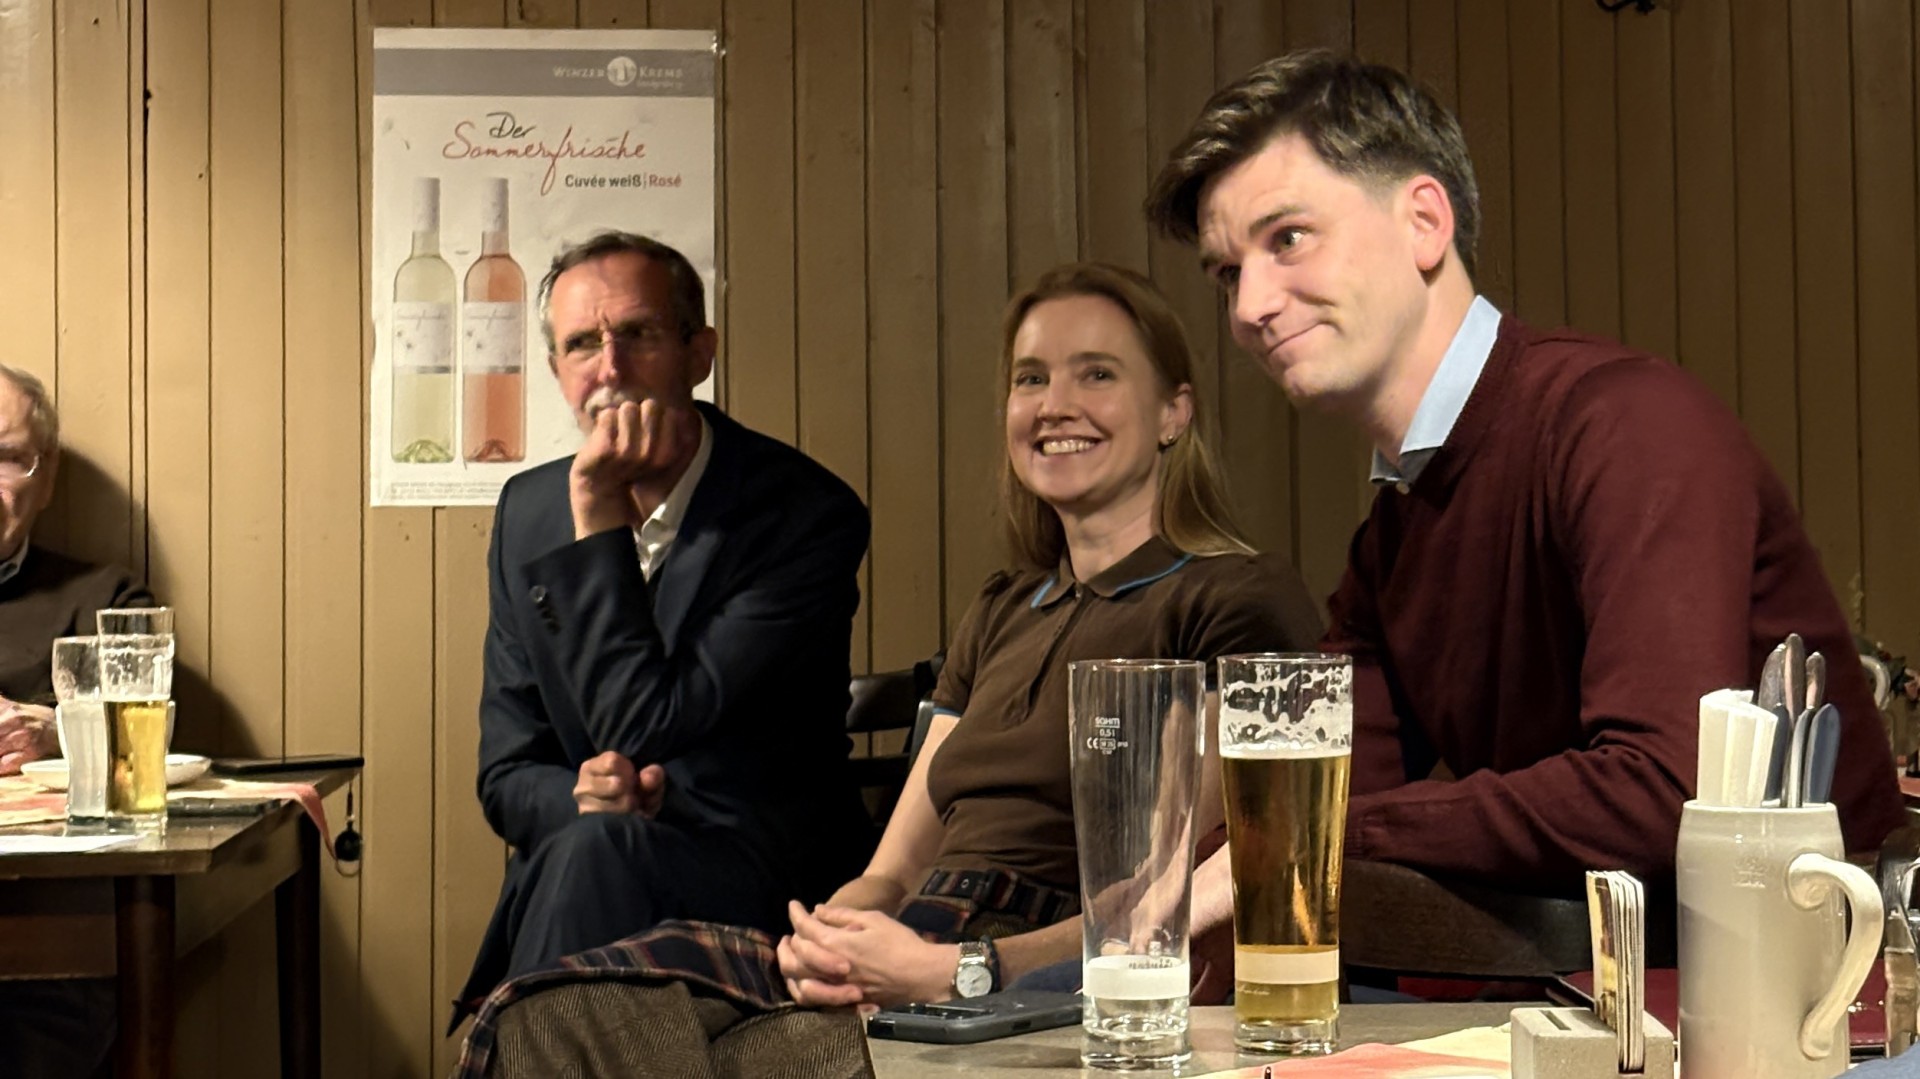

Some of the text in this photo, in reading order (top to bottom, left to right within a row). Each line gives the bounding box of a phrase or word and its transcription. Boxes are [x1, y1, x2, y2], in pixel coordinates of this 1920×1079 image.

[486, 111, 536, 139] Der
[442, 121, 645, 196] Sommerfrische
[565, 173, 606, 188] Cuvée
[649, 173, 682, 188] Rosé
